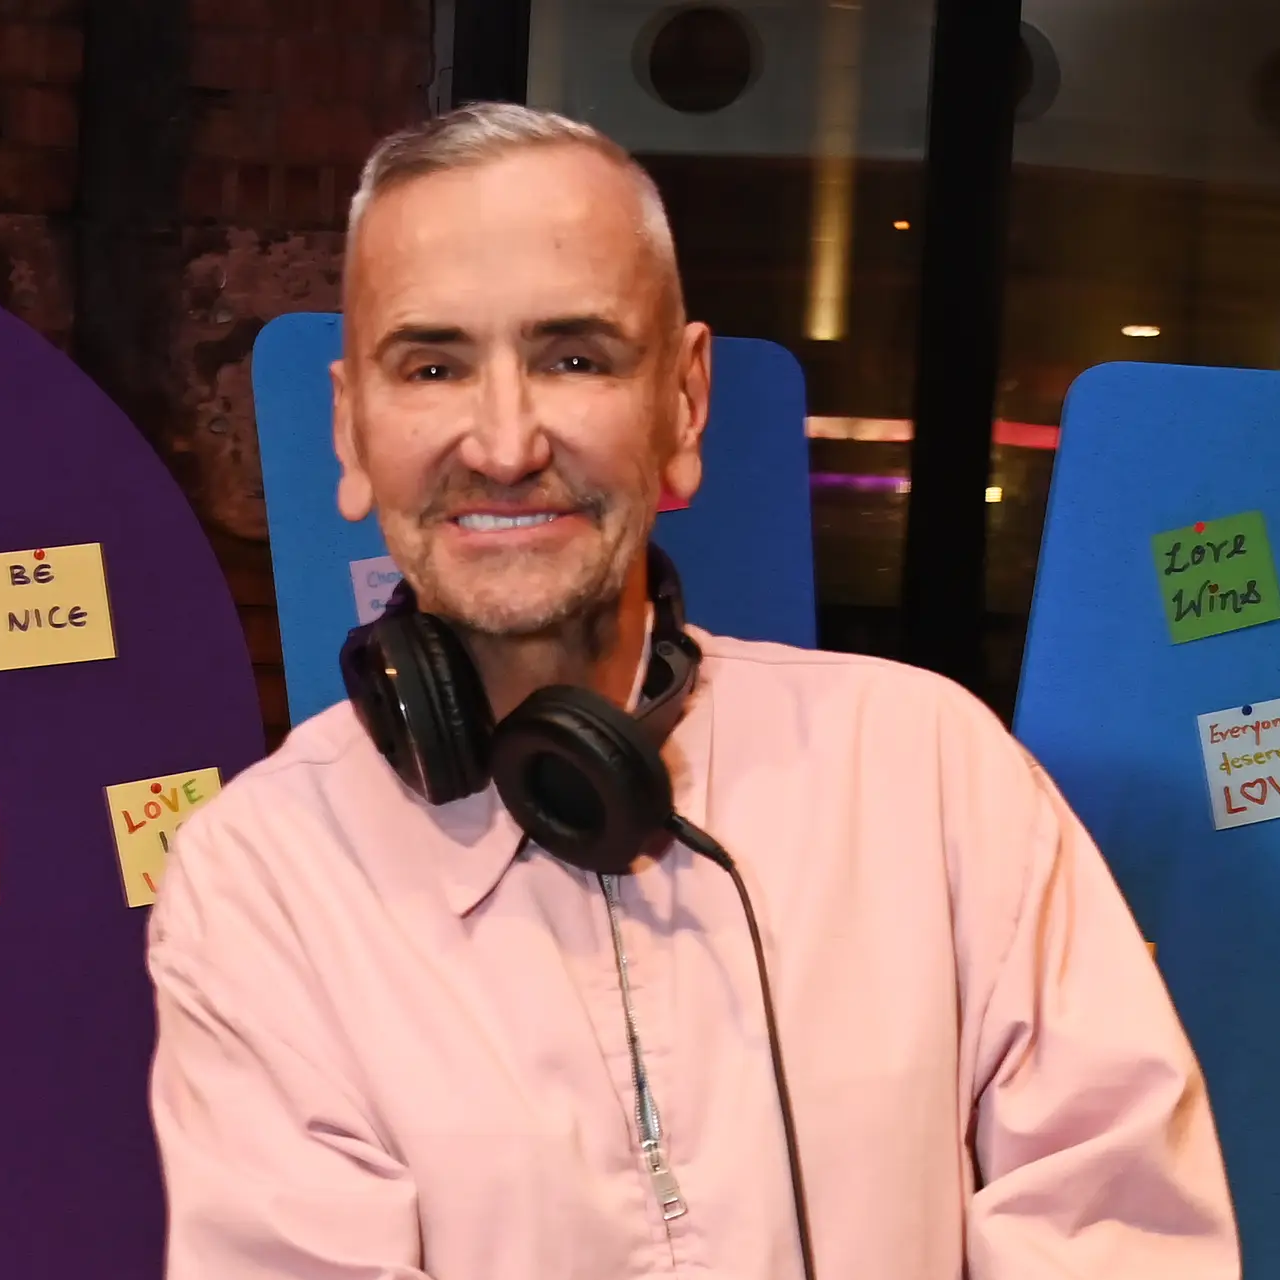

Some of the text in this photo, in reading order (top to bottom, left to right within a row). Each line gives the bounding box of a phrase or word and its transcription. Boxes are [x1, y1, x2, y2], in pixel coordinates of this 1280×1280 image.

[8, 563, 55, 586] BE
[6, 606, 88, 633] NICE
[121, 778, 205, 835] LOVE
